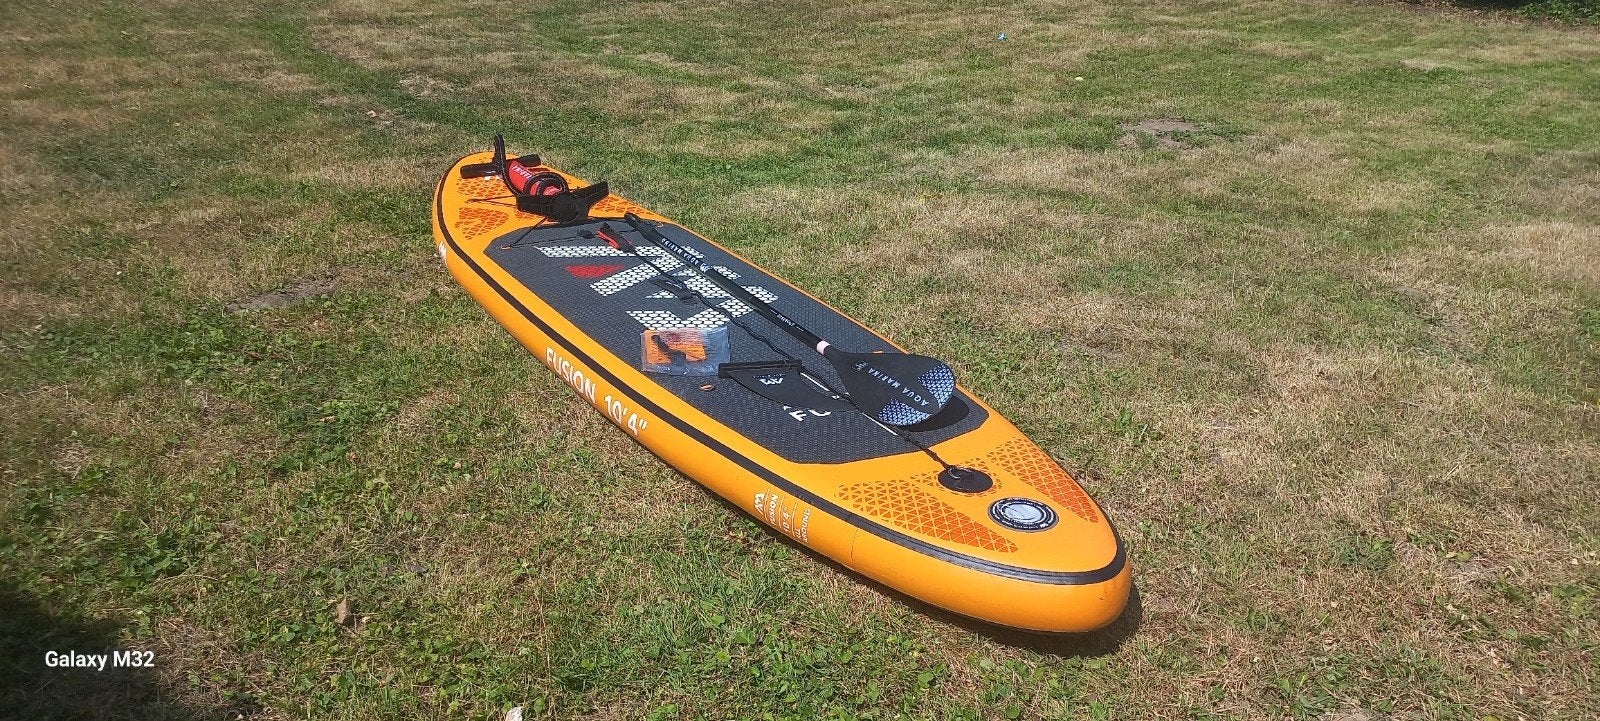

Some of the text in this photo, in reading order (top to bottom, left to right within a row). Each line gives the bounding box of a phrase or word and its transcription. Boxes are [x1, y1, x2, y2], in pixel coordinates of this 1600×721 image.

[547, 347, 597, 405] FUSION
[868, 367, 930, 406] AQUA MARINA
